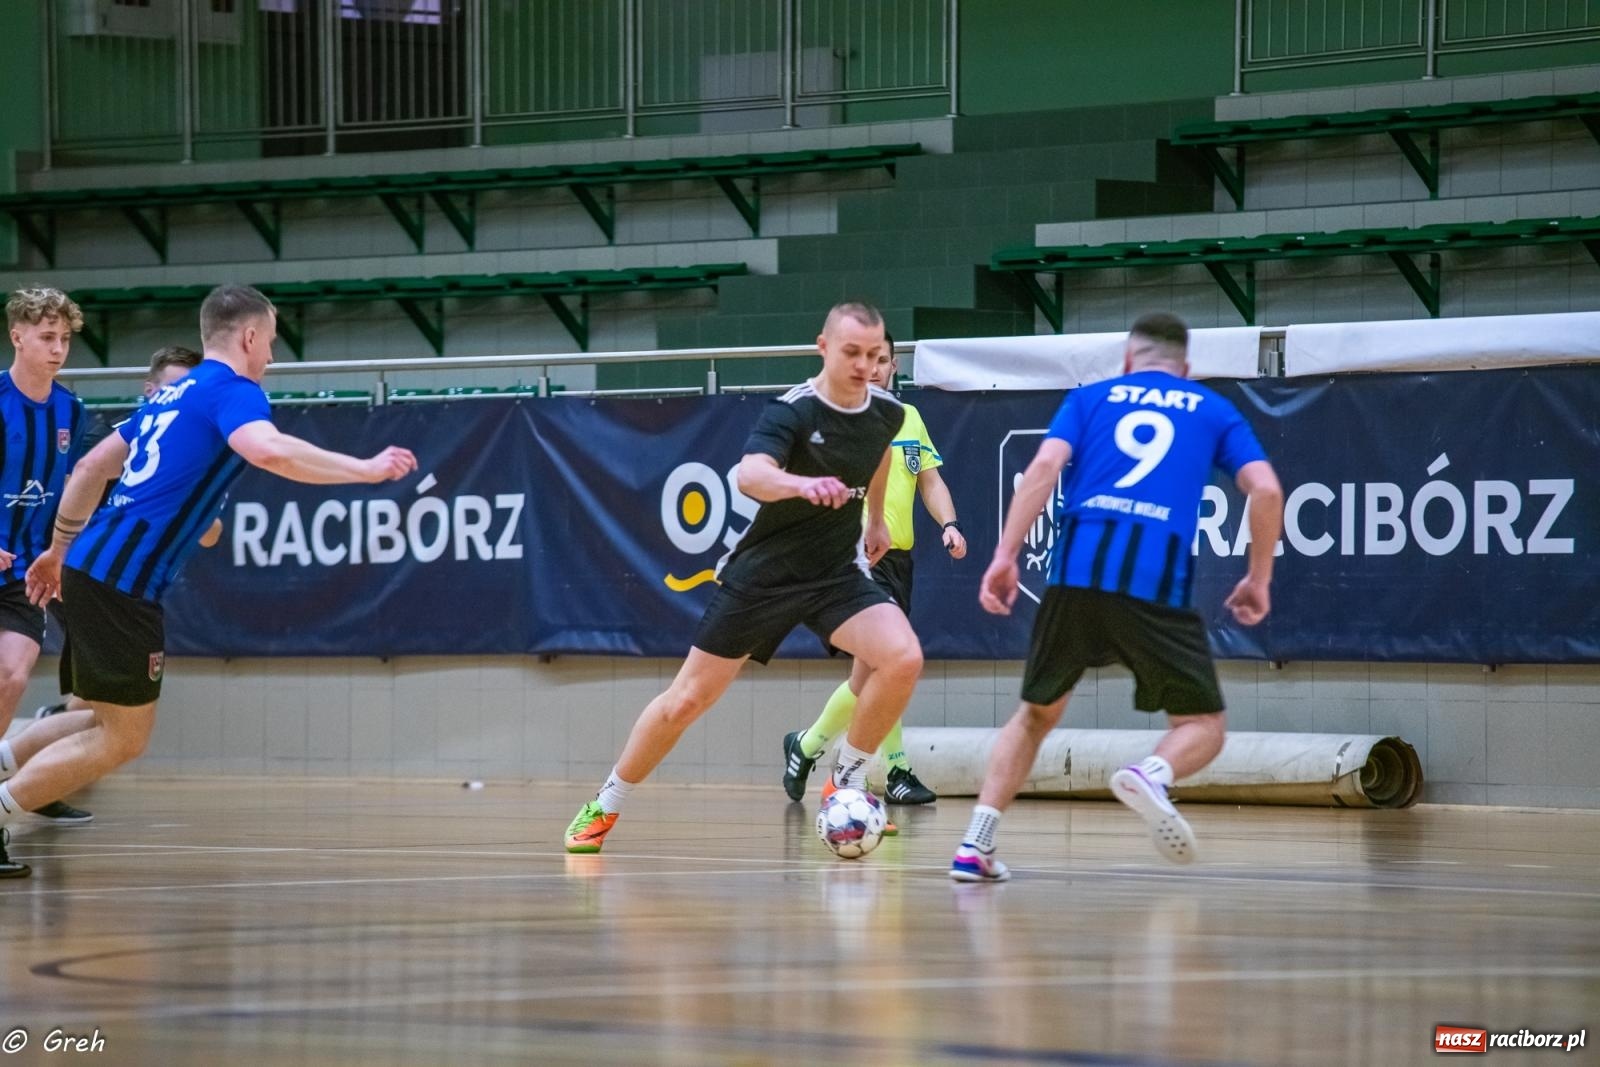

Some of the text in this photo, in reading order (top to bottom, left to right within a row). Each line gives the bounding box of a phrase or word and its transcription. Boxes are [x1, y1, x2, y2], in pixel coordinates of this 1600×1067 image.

[1107, 384, 1204, 413] START
[1113, 409, 1176, 489] 9
[232, 472, 526, 568] RACIBÓRZ
